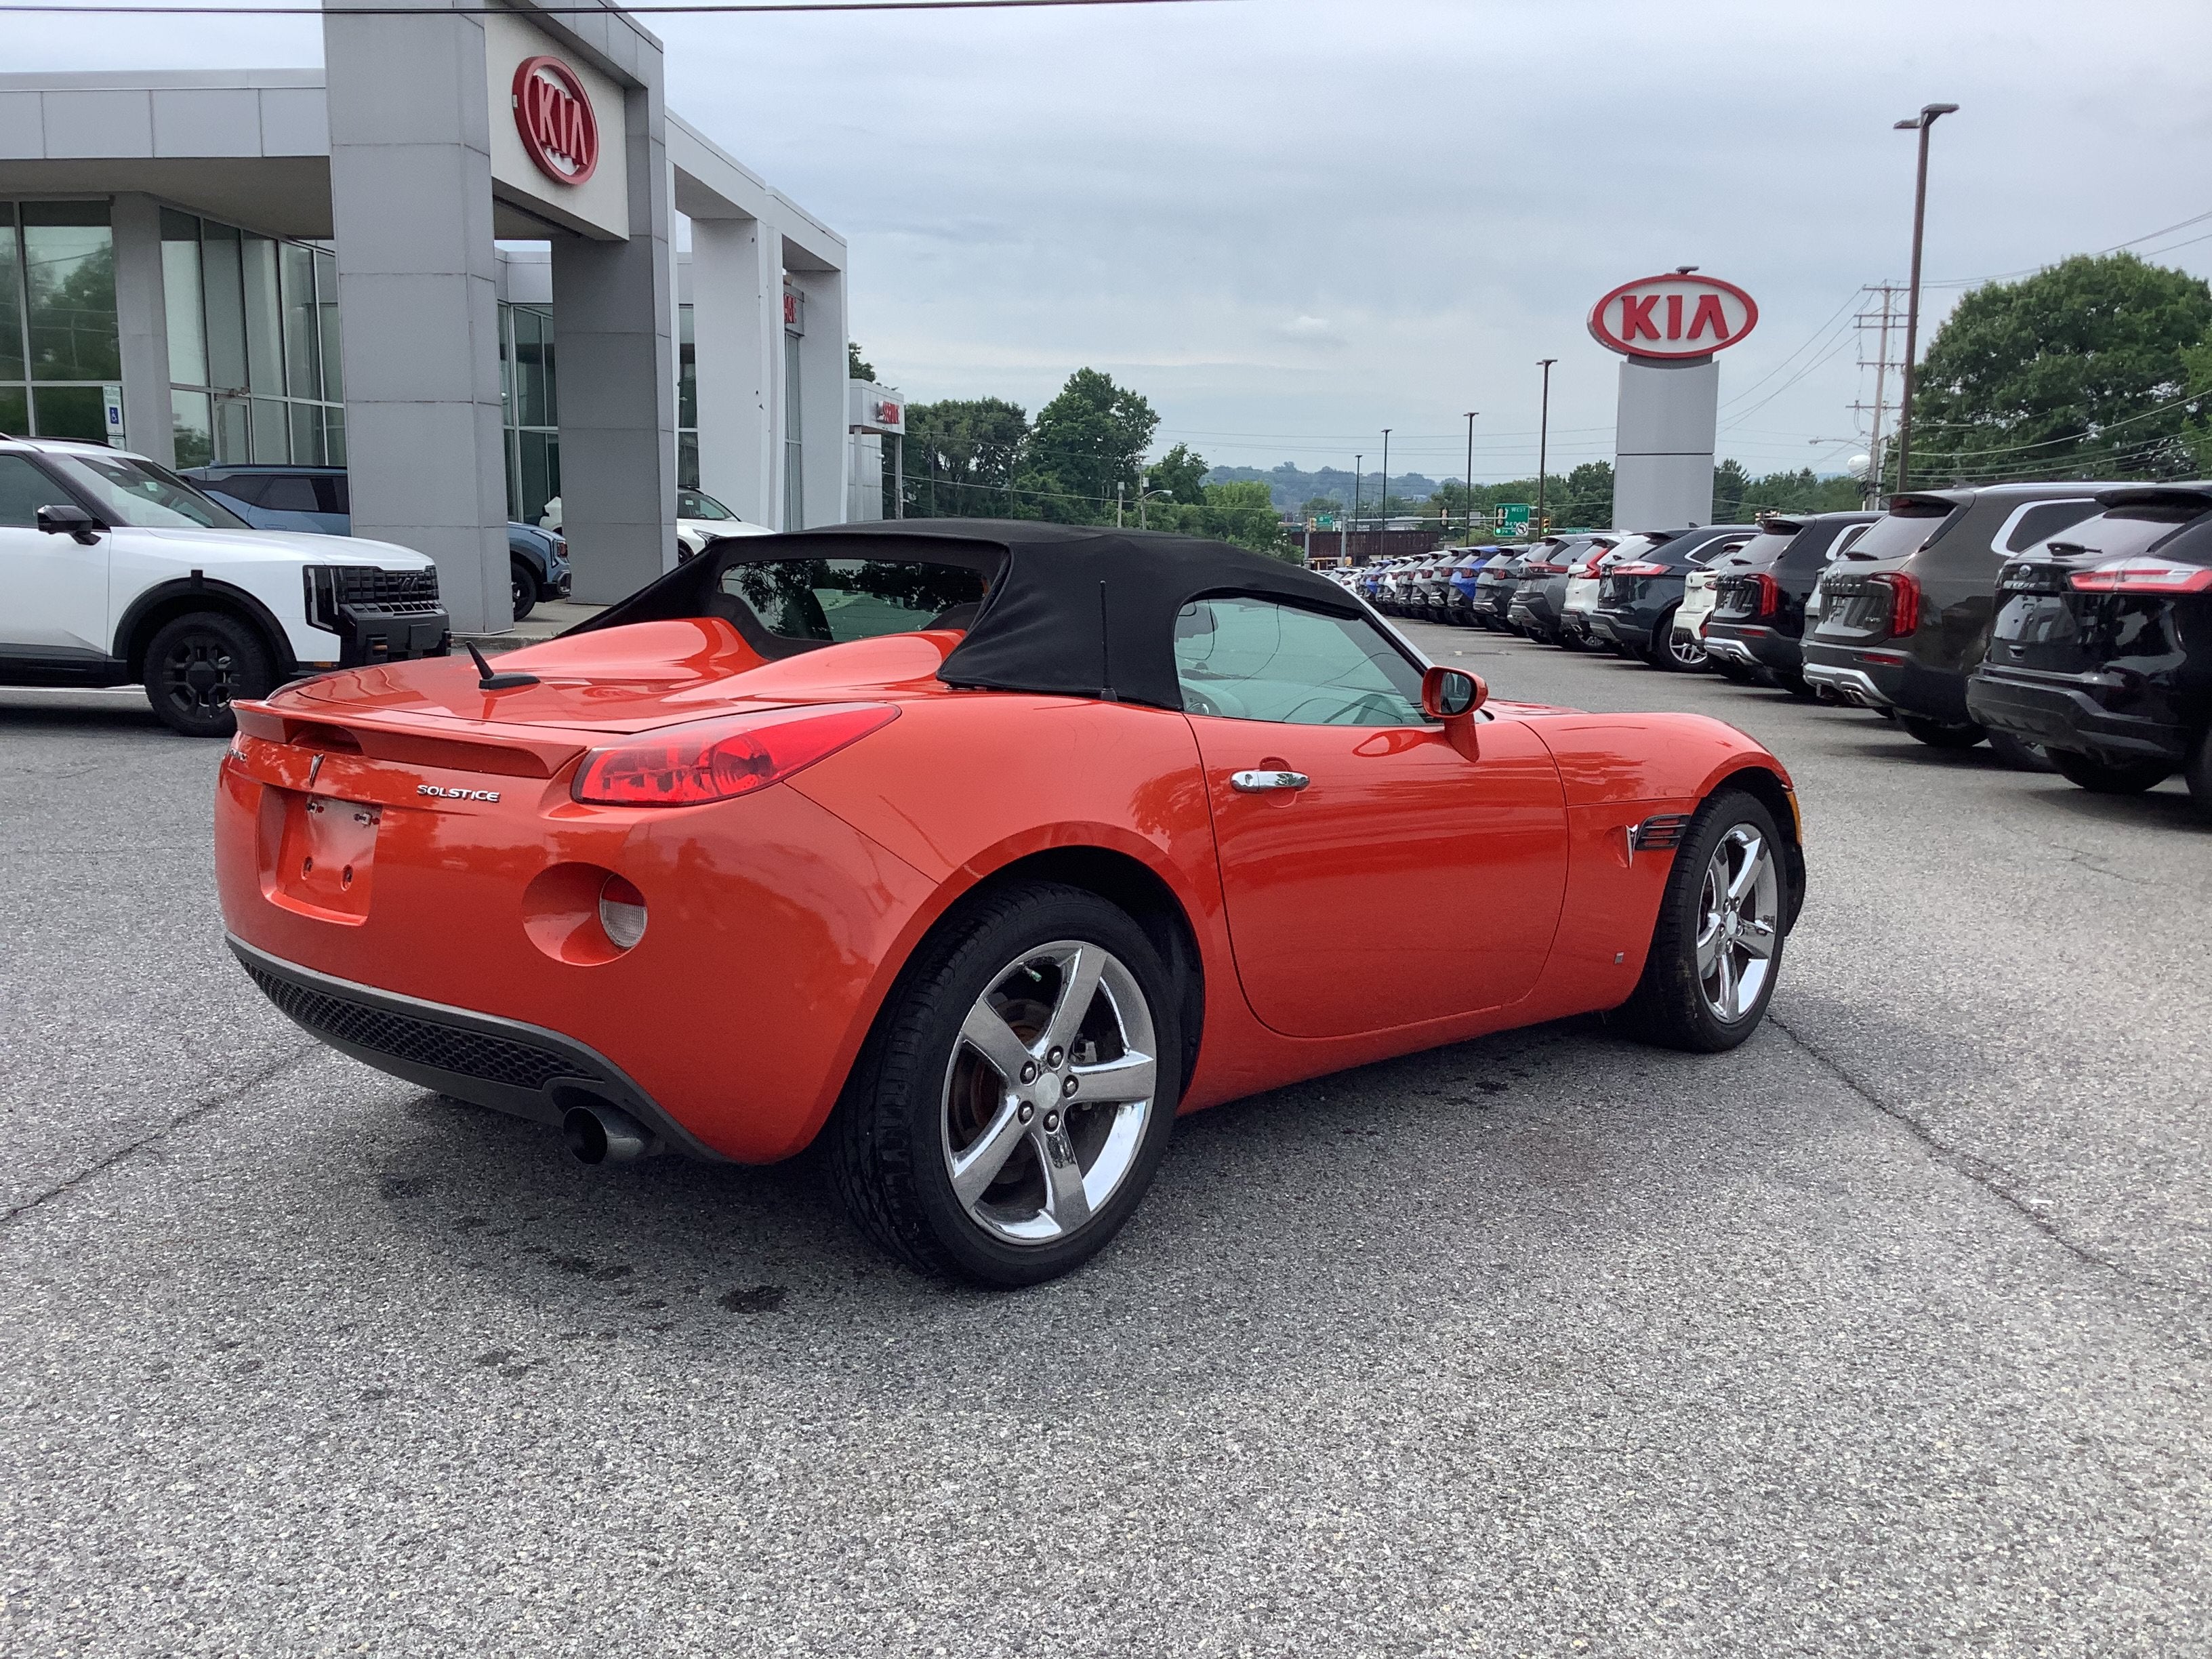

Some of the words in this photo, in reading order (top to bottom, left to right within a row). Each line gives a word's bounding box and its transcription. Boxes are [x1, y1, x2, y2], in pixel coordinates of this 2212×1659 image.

[533, 75, 588, 166] KIA
[1621, 294, 1730, 340] KIA
[416, 785, 501, 803] SOLSTICE
